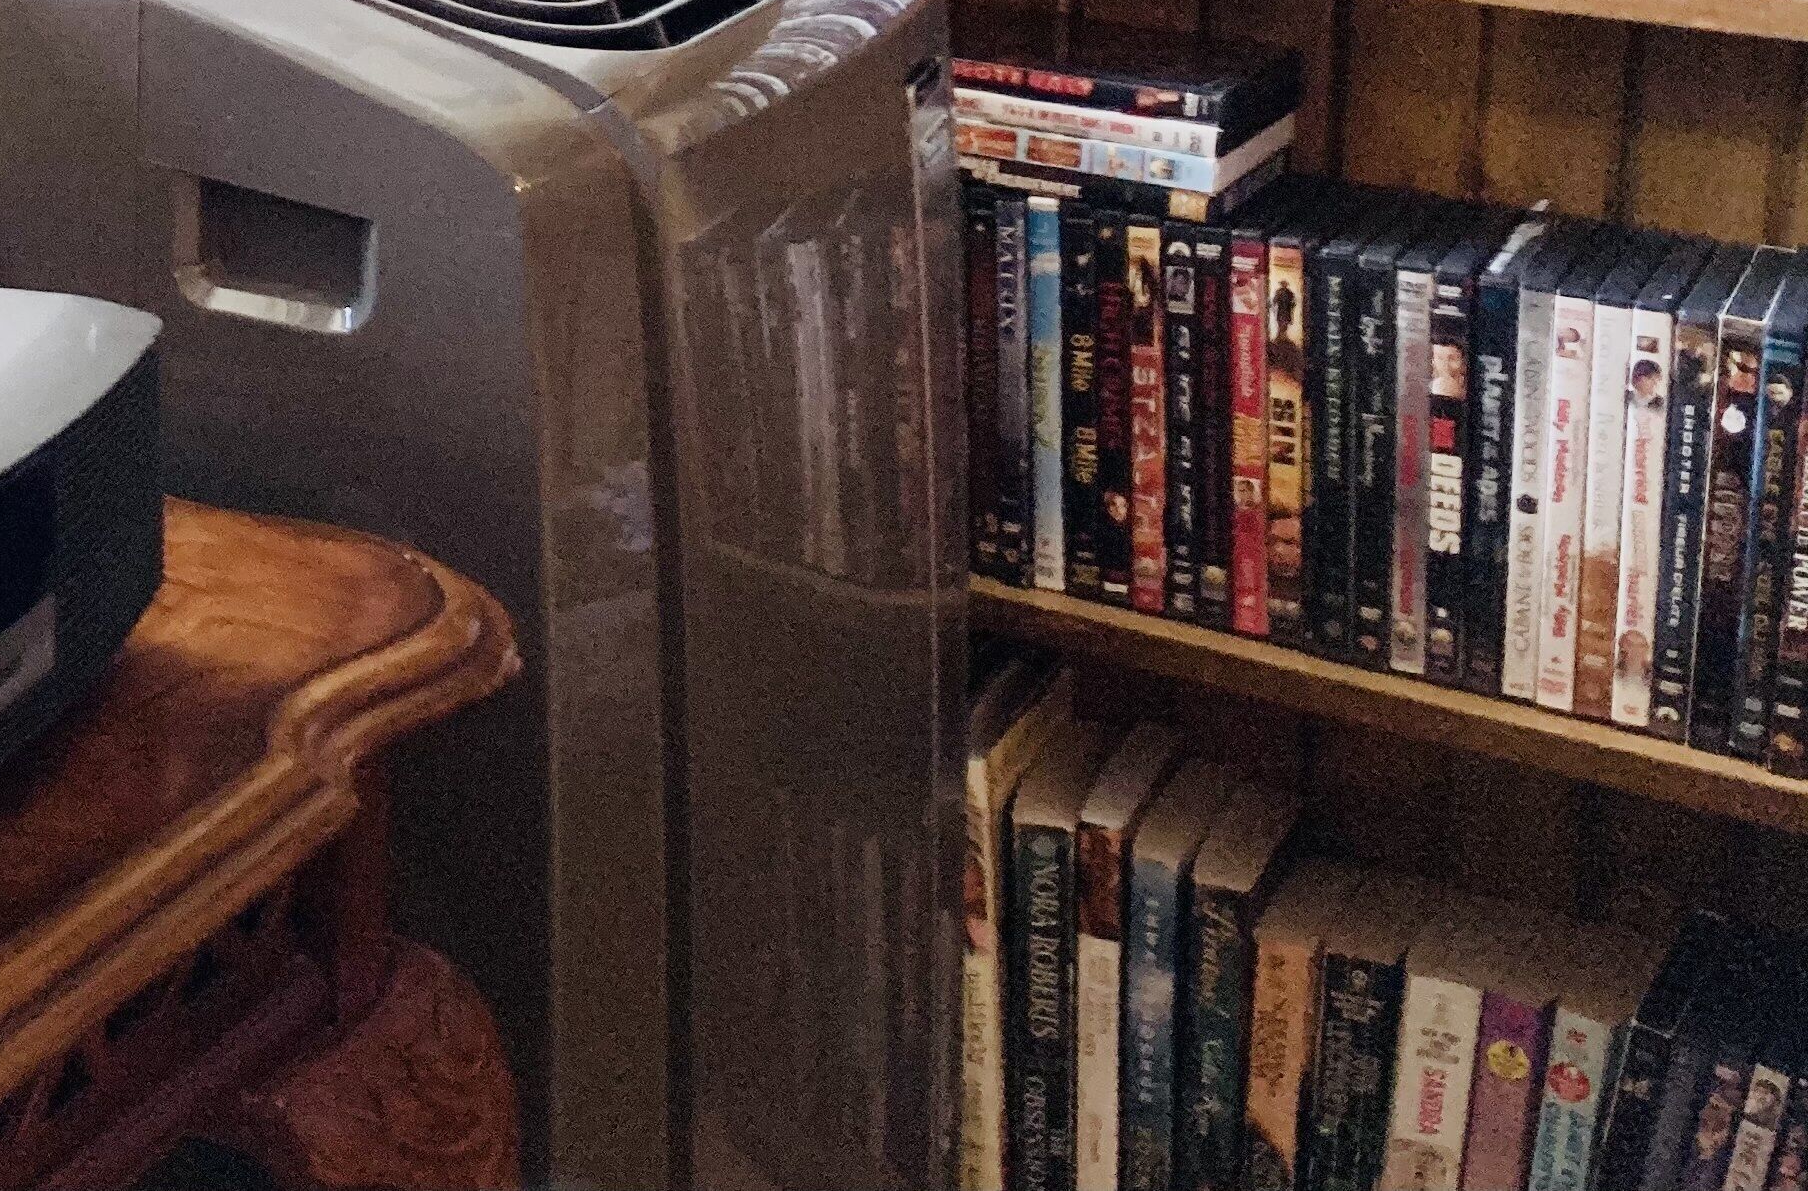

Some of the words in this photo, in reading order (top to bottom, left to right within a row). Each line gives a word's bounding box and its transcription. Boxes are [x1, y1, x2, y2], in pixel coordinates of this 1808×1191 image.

[1072, 333, 1094, 348] 8
[1073, 350, 1094, 392] Mile
[1075, 426, 1097, 440] 8
[1552, 398, 1571, 432] Billy
[1075, 442, 1097, 485] Mile
[1678, 404, 1696, 495] SHOOTER
[1429, 453, 1463, 554] DEEDS
[1030, 862, 1060, 928] NORA
[1028, 935, 1059, 1040] ROBERTS
[1419, 1066, 1447, 1135] SANDRA
